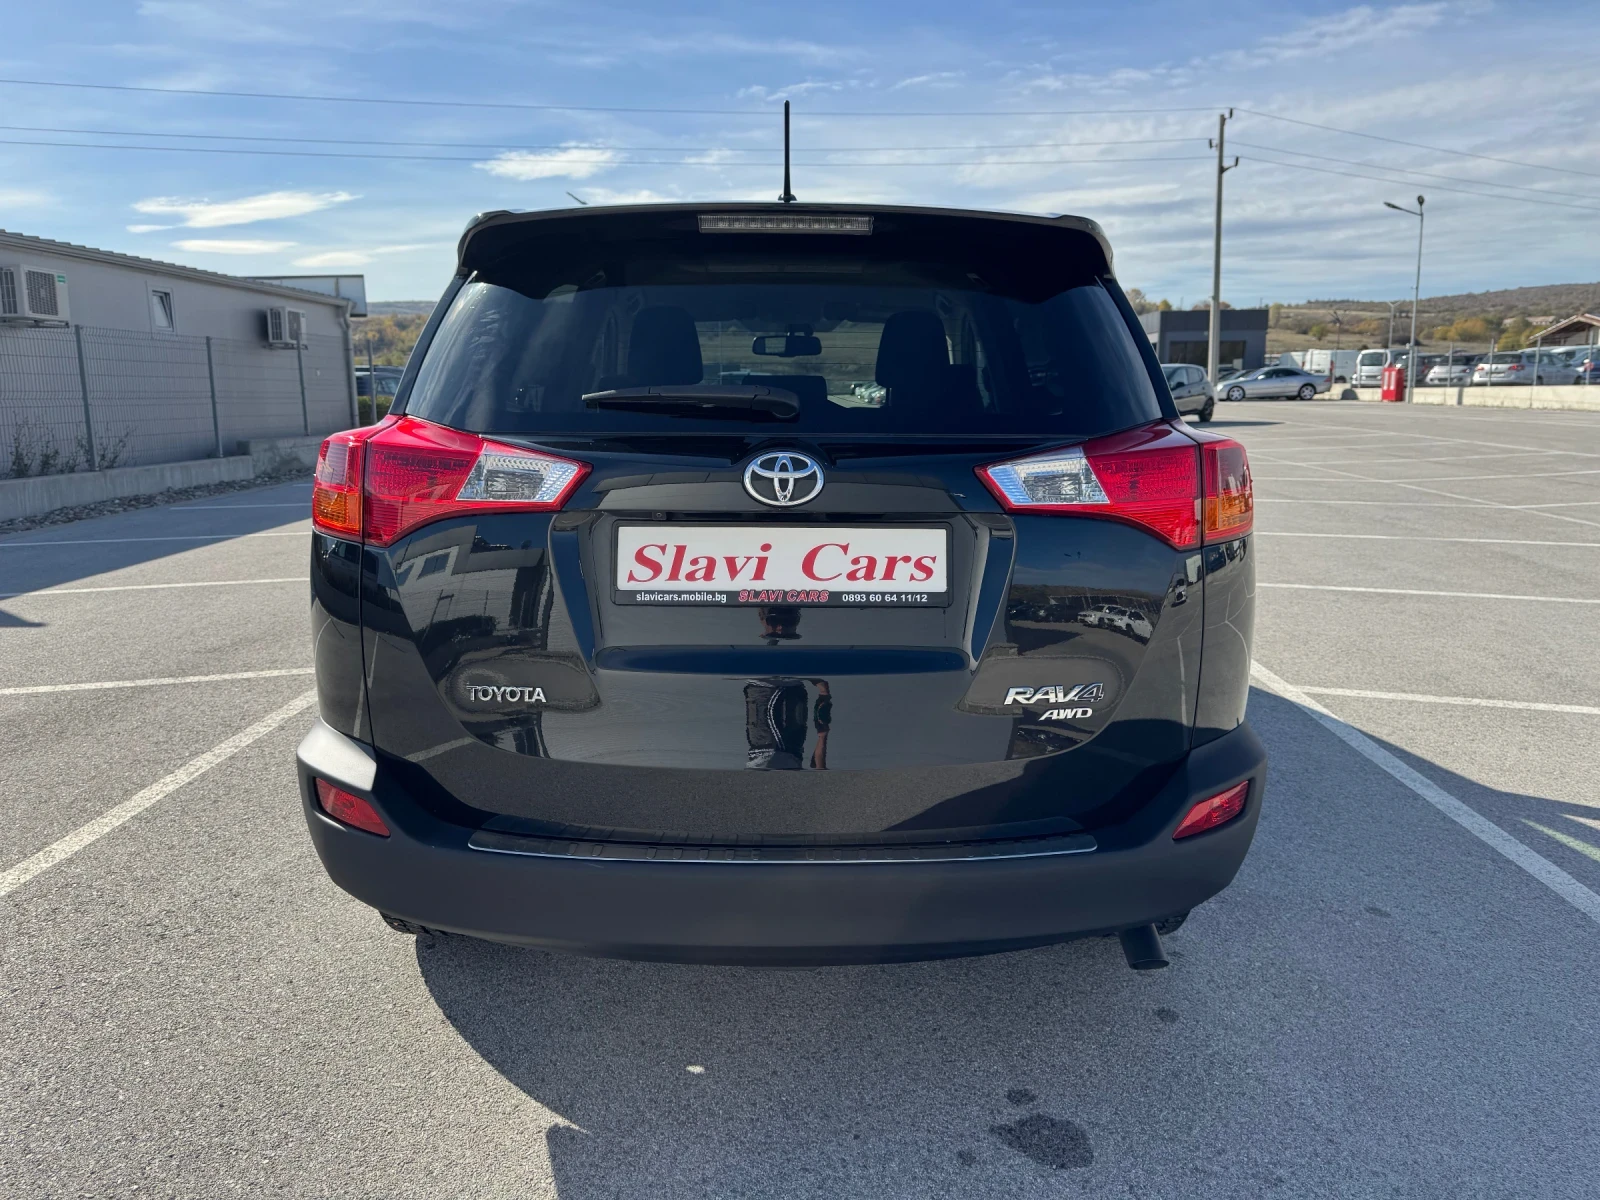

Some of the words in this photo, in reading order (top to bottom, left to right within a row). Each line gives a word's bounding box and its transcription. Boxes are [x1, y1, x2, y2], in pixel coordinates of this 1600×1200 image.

[627, 543, 772, 583] Slavi
[801, 542, 937, 582] Cars
[636, 592, 727, 603] slavicars.mobile.bg
[738, 589, 783, 602] SLAVI
[786, 589, 829, 602] CARS
[842, 594, 866, 602] 0893
[869, 594, 882, 602] 60
[884, 594, 897, 602] 64
[900, 594, 928, 602] 11/12
[466, 685, 546, 703] TOYOTA
[1004, 682, 1104, 705] RAV4
[1038, 707, 1093, 721] AWD
